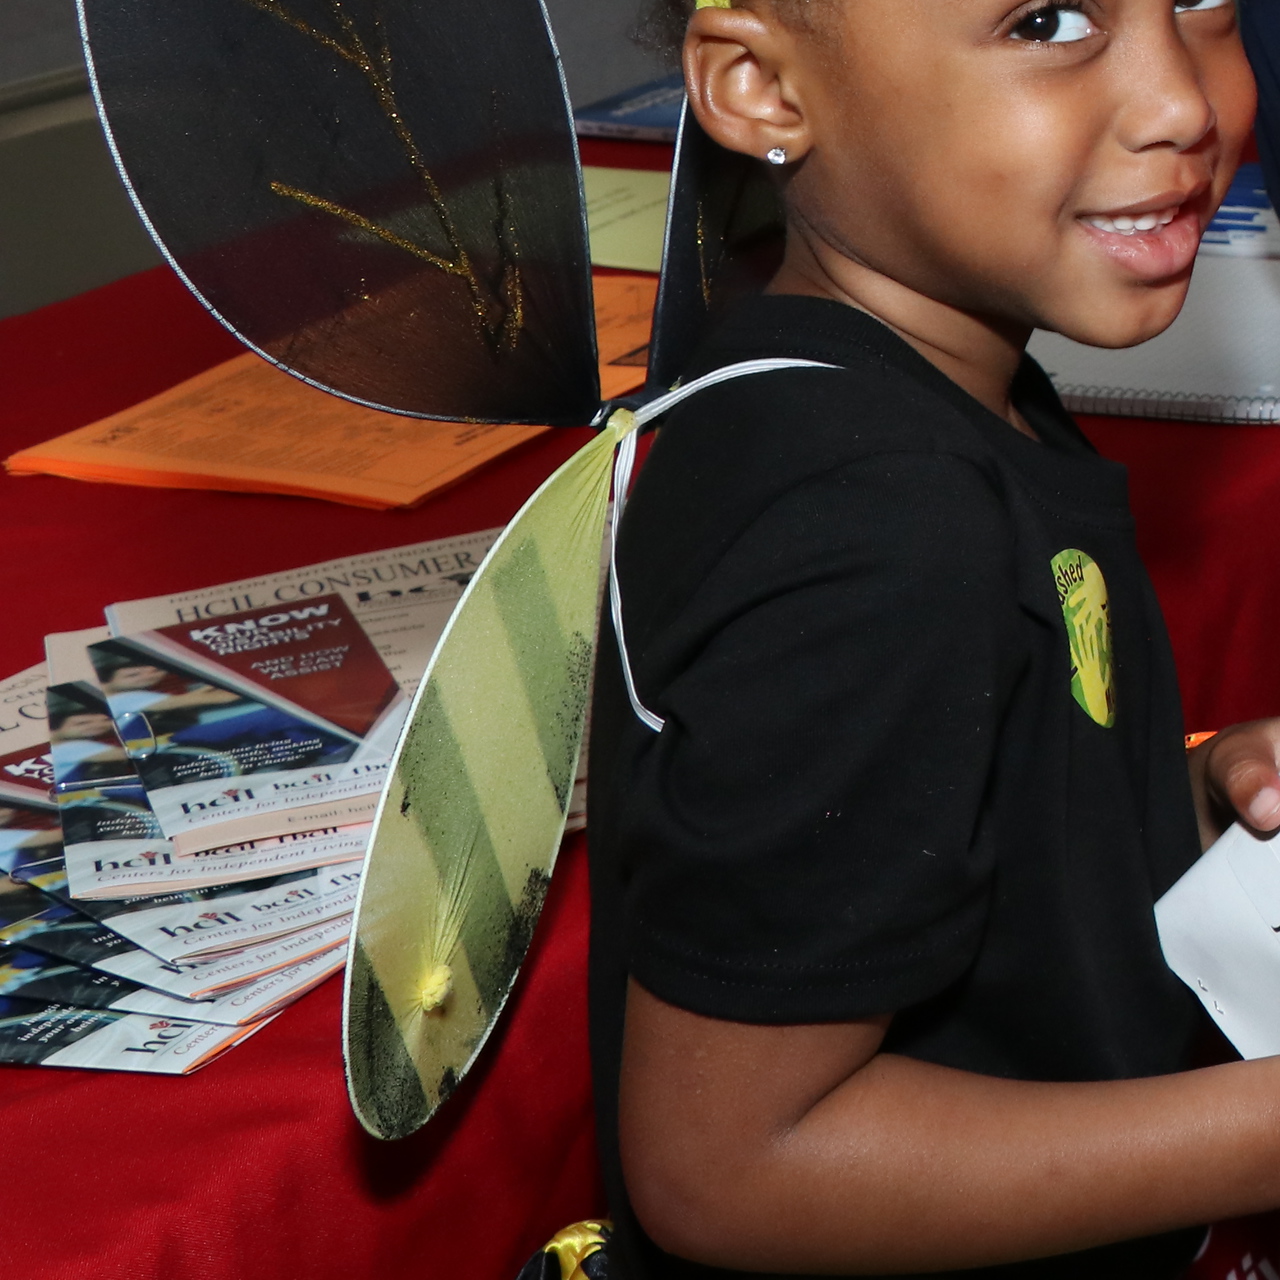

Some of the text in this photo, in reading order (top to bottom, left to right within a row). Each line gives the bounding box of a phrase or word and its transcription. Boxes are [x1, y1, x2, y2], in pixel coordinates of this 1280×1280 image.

[175, 593, 266, 623] HCIL
[274, 551, 479, 602] CONSUMER
[189, 603, 330, 642] KNOW
[251, 645, 350, 670] AND HOW
[259, 653, 343, 675] WE CAN
[270, 660, 342, 681] ASSIST
[180, 788, 256, 816] hcil
[187, 805, 250, 824] Centers
[255, 799, 277, 810] for
[94, 851, 172, 873] hcil
[97, 839, 364, 882] Centers for Independent Living
[158, 911, 243, 938] hcil
[183, 926, 248, 946] Centers
[251, 920, 274, 933] for
[193, 958, 255, 981] Centers
[256, 950, 278, 963] for
[230, 966, 303, 1007] Centers for
[38, 1023, 65, 1044] your
